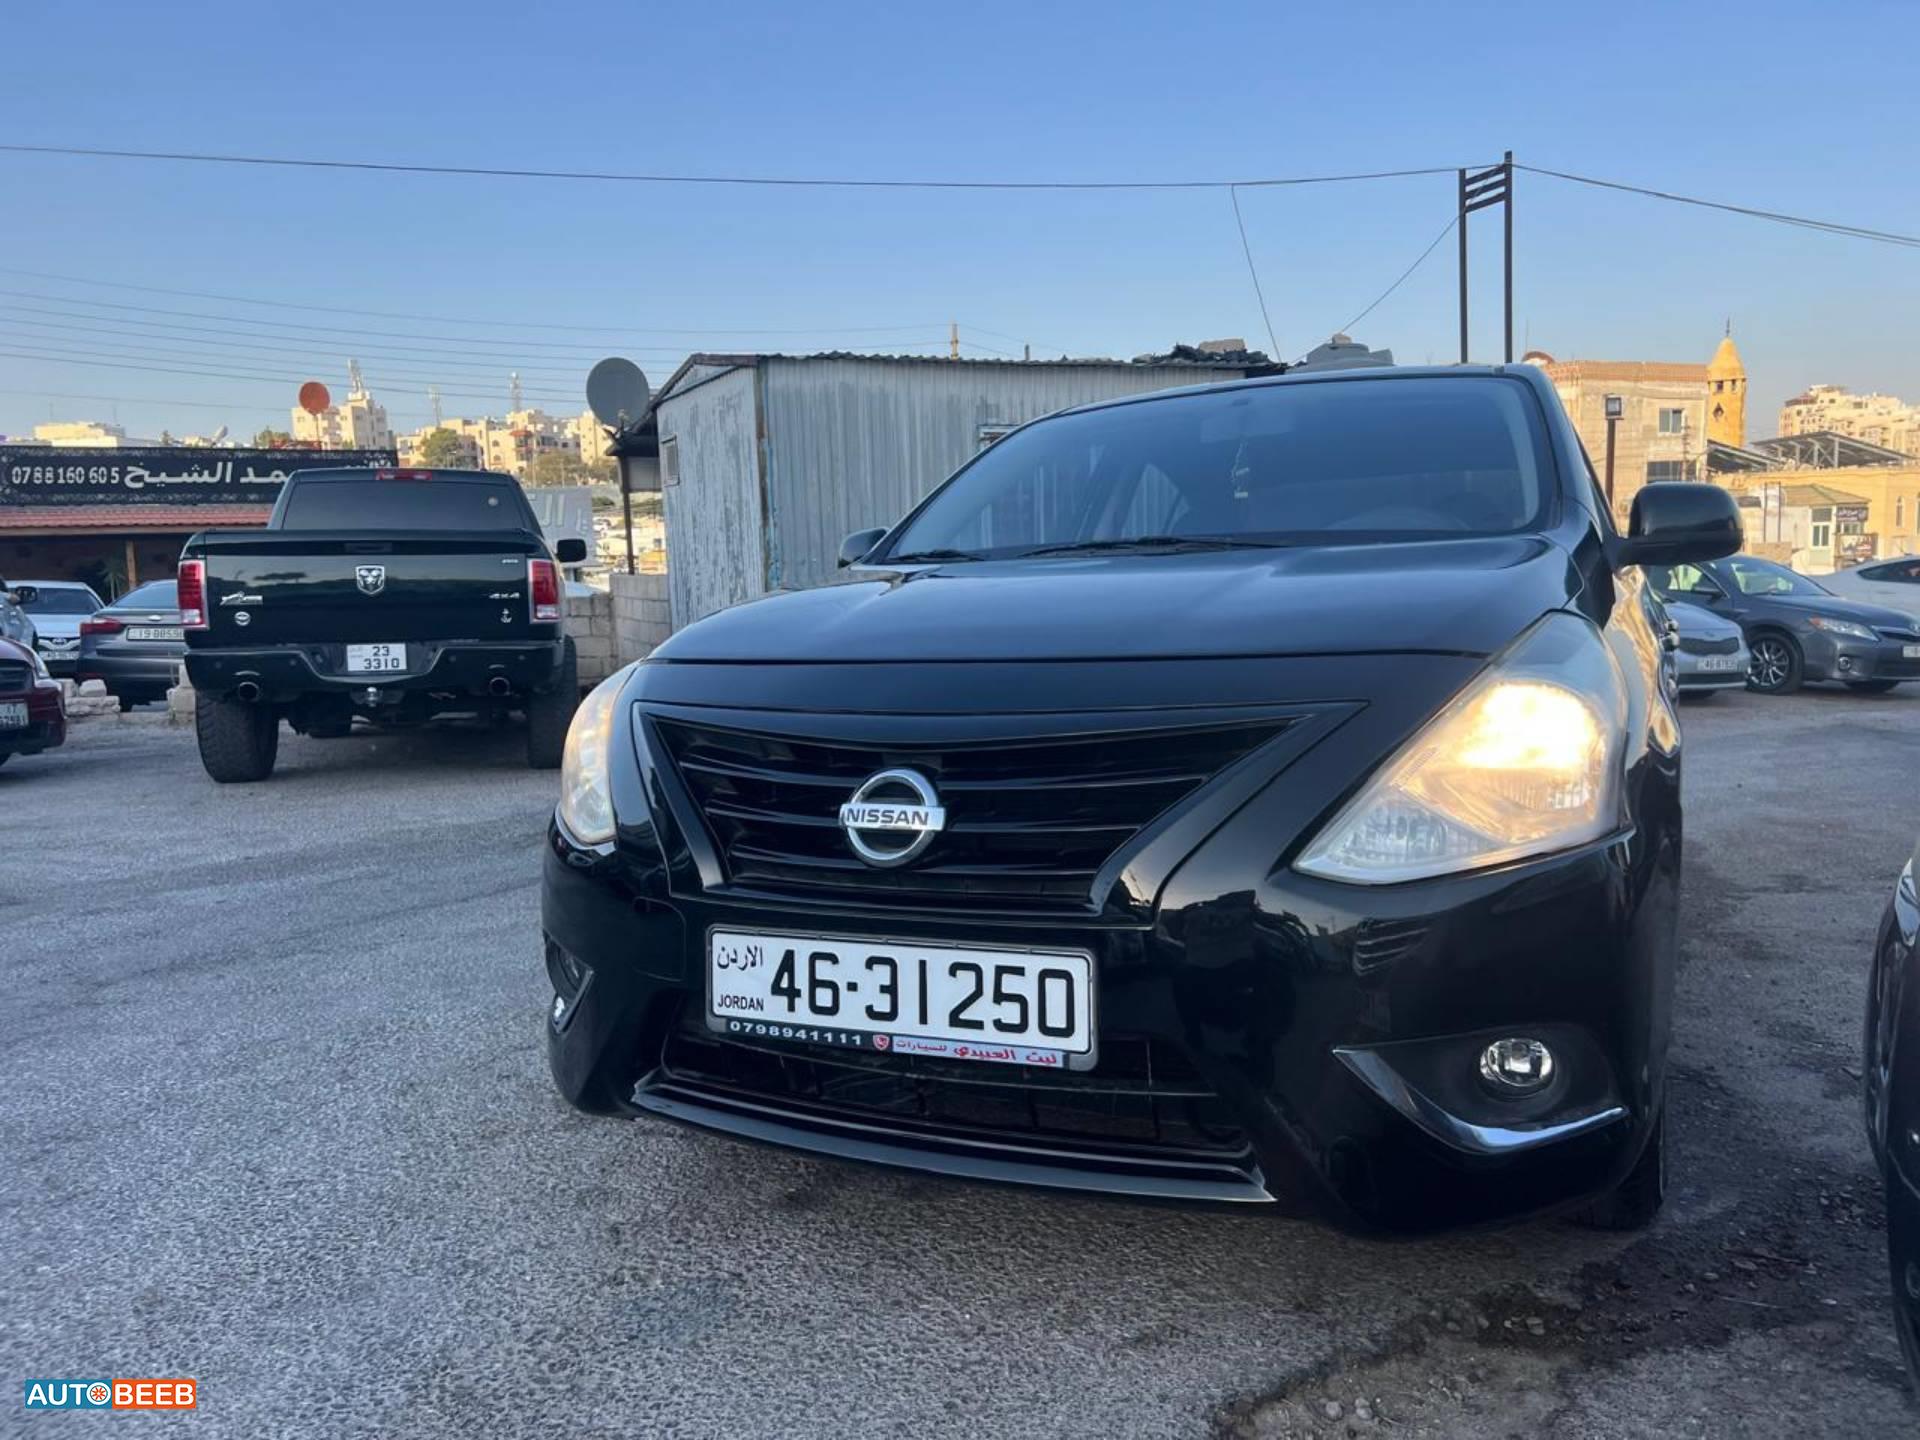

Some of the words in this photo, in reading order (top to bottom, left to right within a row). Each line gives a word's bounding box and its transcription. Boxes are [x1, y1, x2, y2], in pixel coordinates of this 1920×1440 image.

[124, 461, 233, 488] الشيخ
[372, 645, 390, 657] 23
[363, 657, 401, 670] 3310
[846, 807, 929, 826] NISSAN
[717, 993, 764, 1012] JORDAN
[770, 948, 1076, 1039] 46-31250
[729, 1020, 862, 1046] 0798941111
